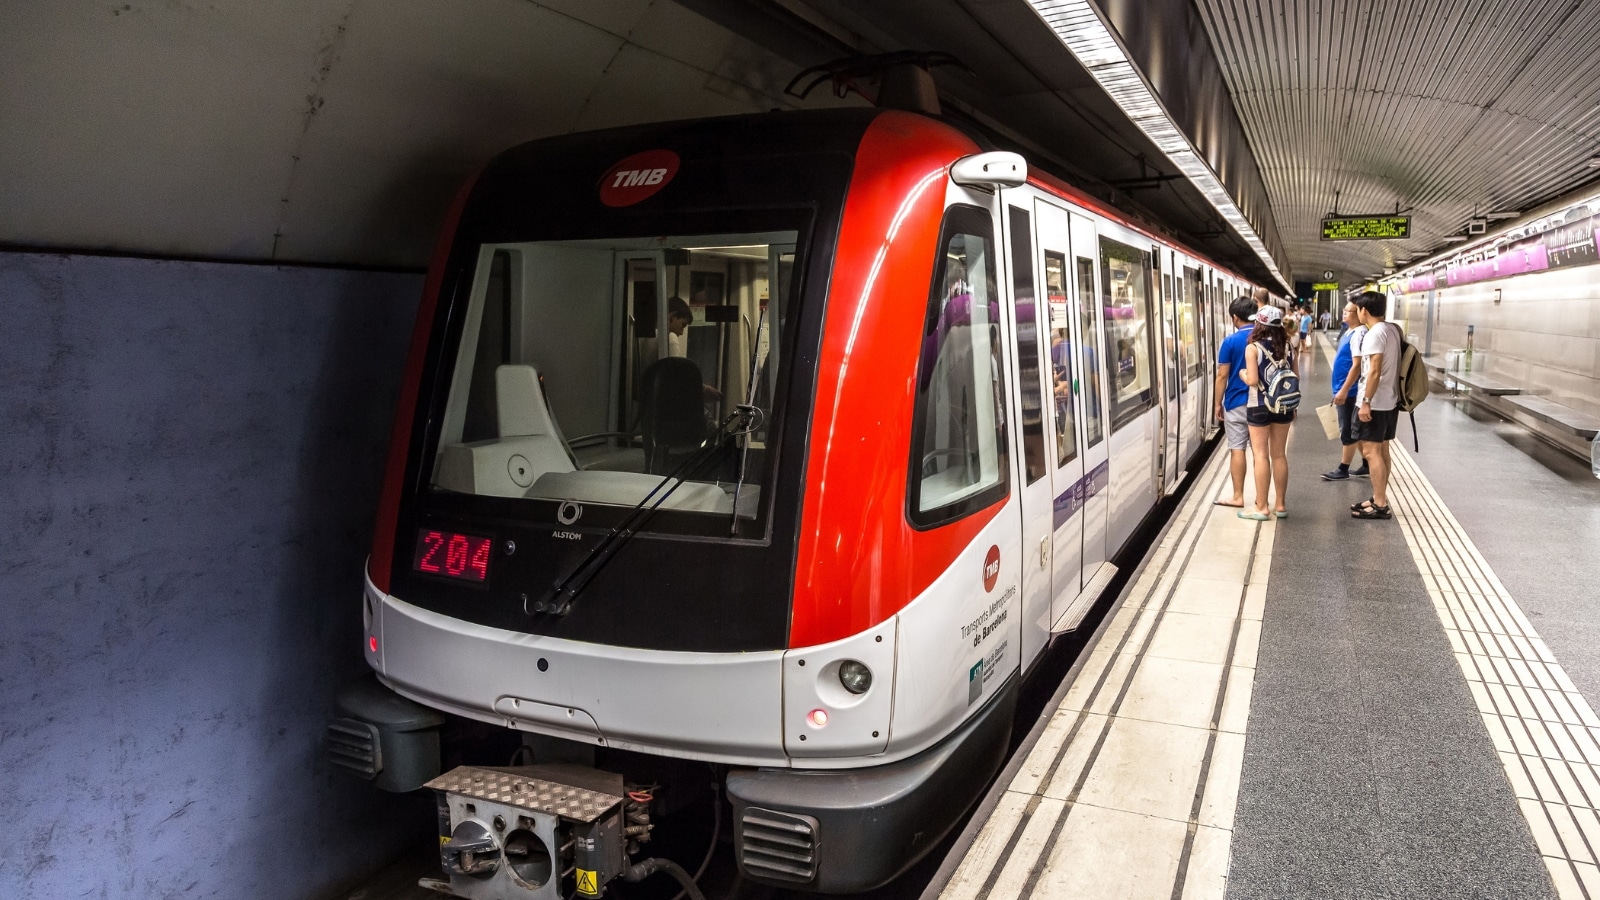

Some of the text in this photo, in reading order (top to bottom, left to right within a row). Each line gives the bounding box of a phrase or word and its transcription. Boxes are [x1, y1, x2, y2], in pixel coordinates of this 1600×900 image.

[612, 168, 668, 188] TMB
[552, 530, 582, 541] ALSTOM
[420, 531, 491, 580] 204
[986, 560, 999, 578] TMB
[961, 585, 1016, 640] Transports Metropolitans
[974, 610, 1008, 647] de Barcelona
